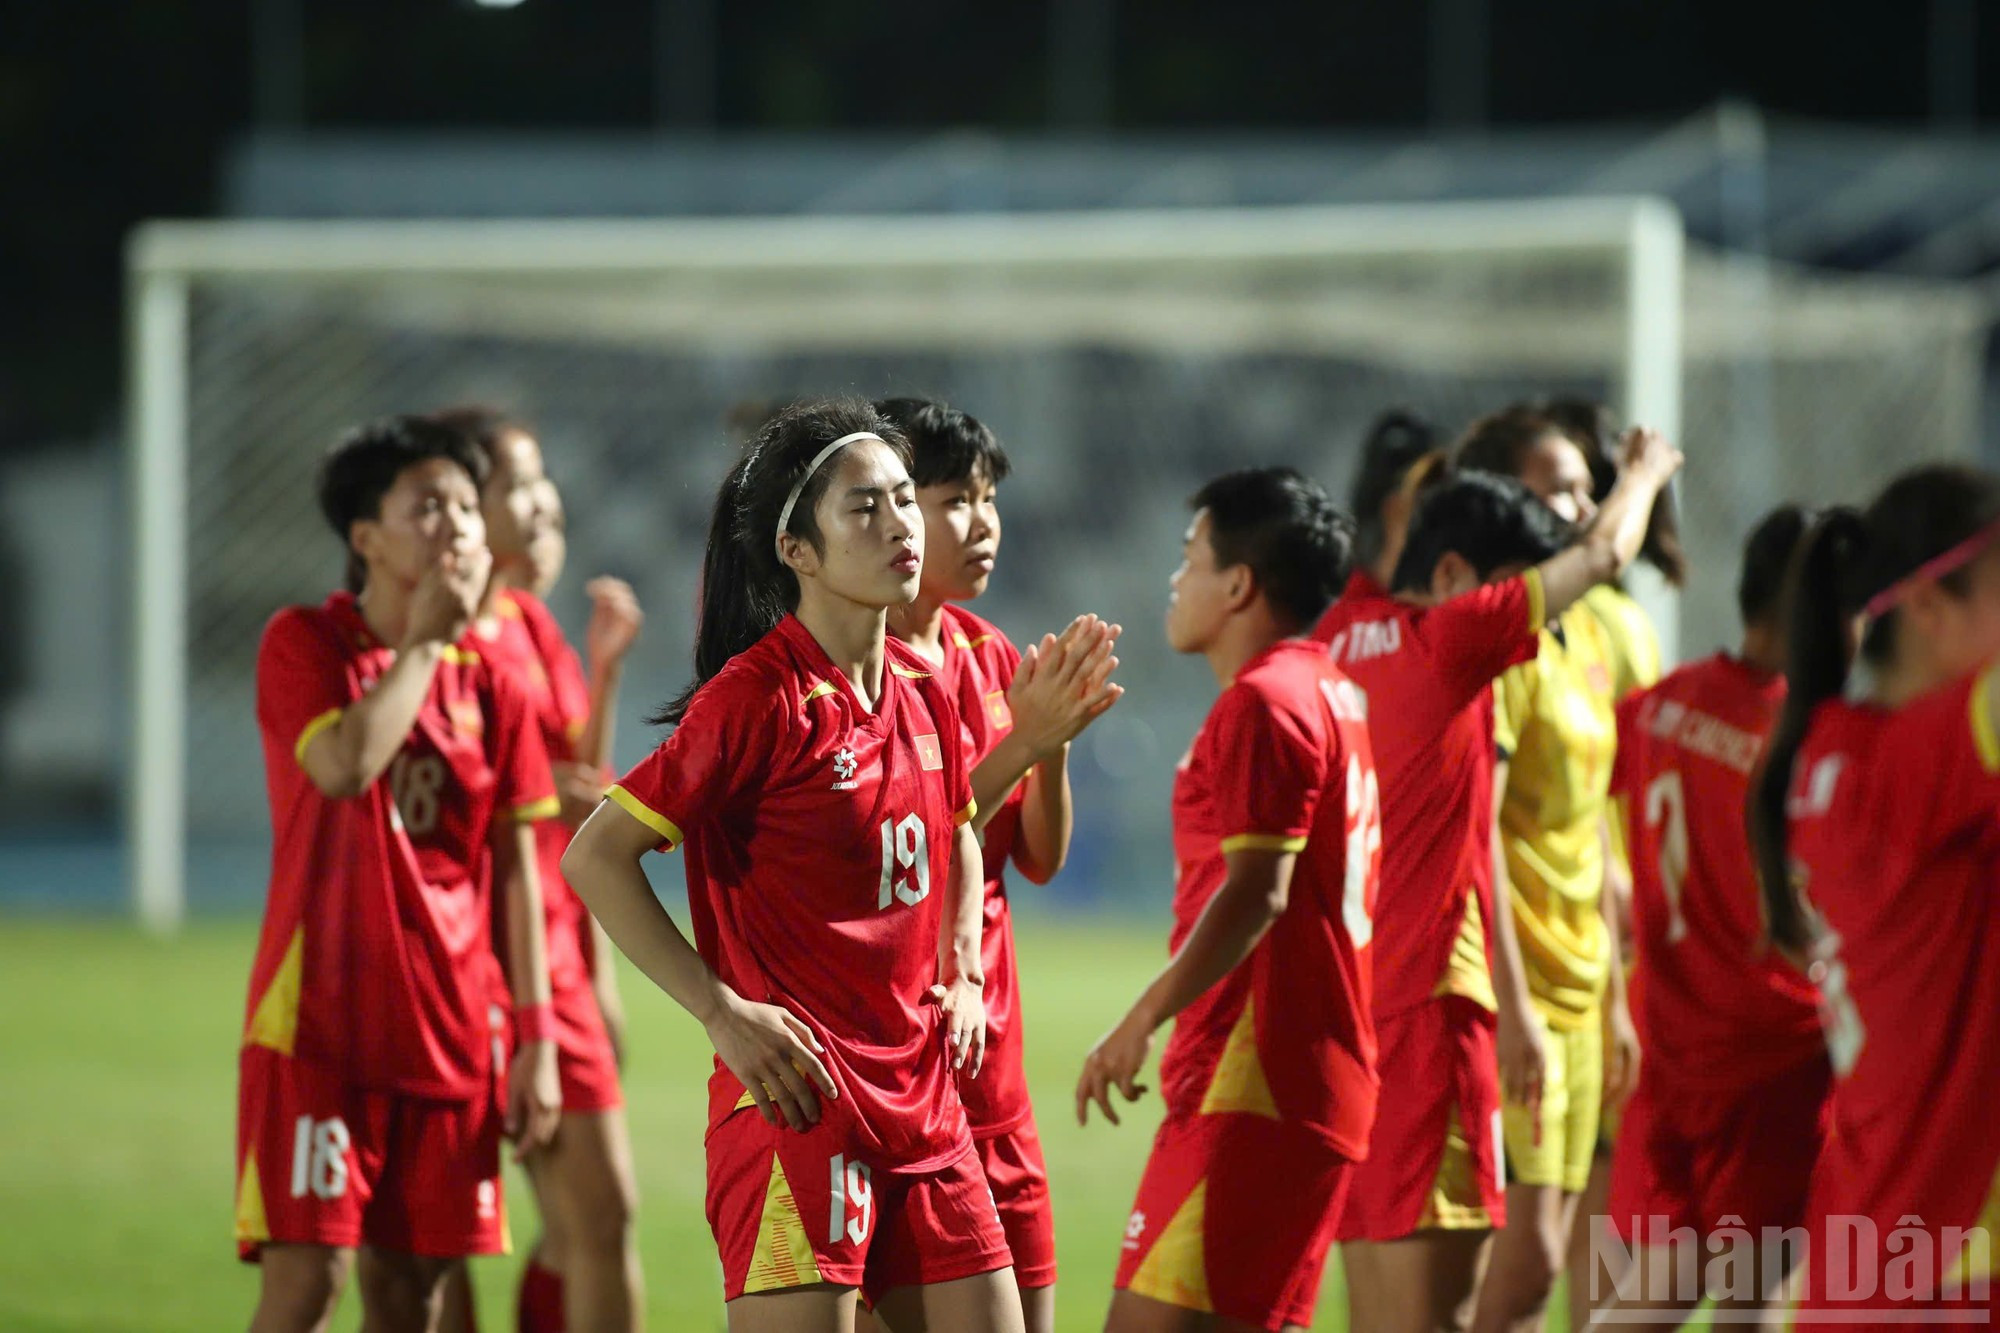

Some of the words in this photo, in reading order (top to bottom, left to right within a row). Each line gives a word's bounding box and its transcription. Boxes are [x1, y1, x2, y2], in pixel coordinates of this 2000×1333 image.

[878, 812, 930, 911] 19
[291, 1114, 350, 1200] 18
[829, 1152, 872, 1247] 19
